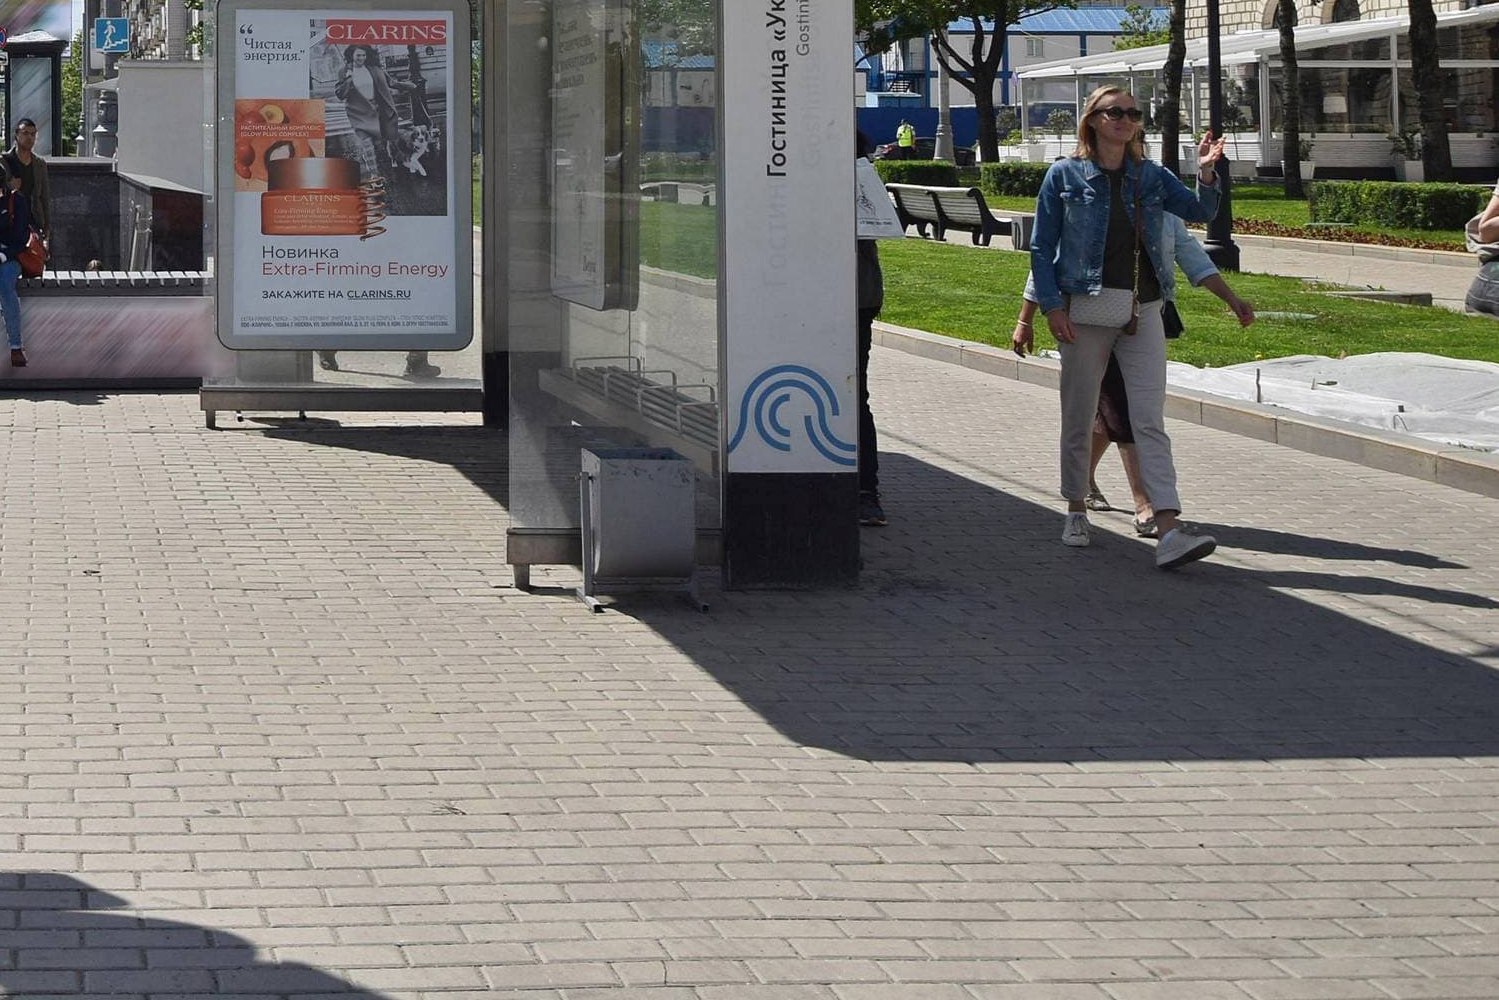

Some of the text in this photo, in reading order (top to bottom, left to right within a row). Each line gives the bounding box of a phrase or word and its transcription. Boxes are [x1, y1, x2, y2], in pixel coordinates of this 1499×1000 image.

[326, 24, 447, 40] CLARINS
[244, 38, 292, 50] Чистая
[766, 50, 789, 177] Гостиница
[284, 194, 341, 202] CLARINS
[262, 246, 339, 259] Новинка
[262, 261, 449, 278] Extra-Firming Energy
[262, 290, 411, 299] ЗАКАЖИТЕ НА CLARINS.RU
